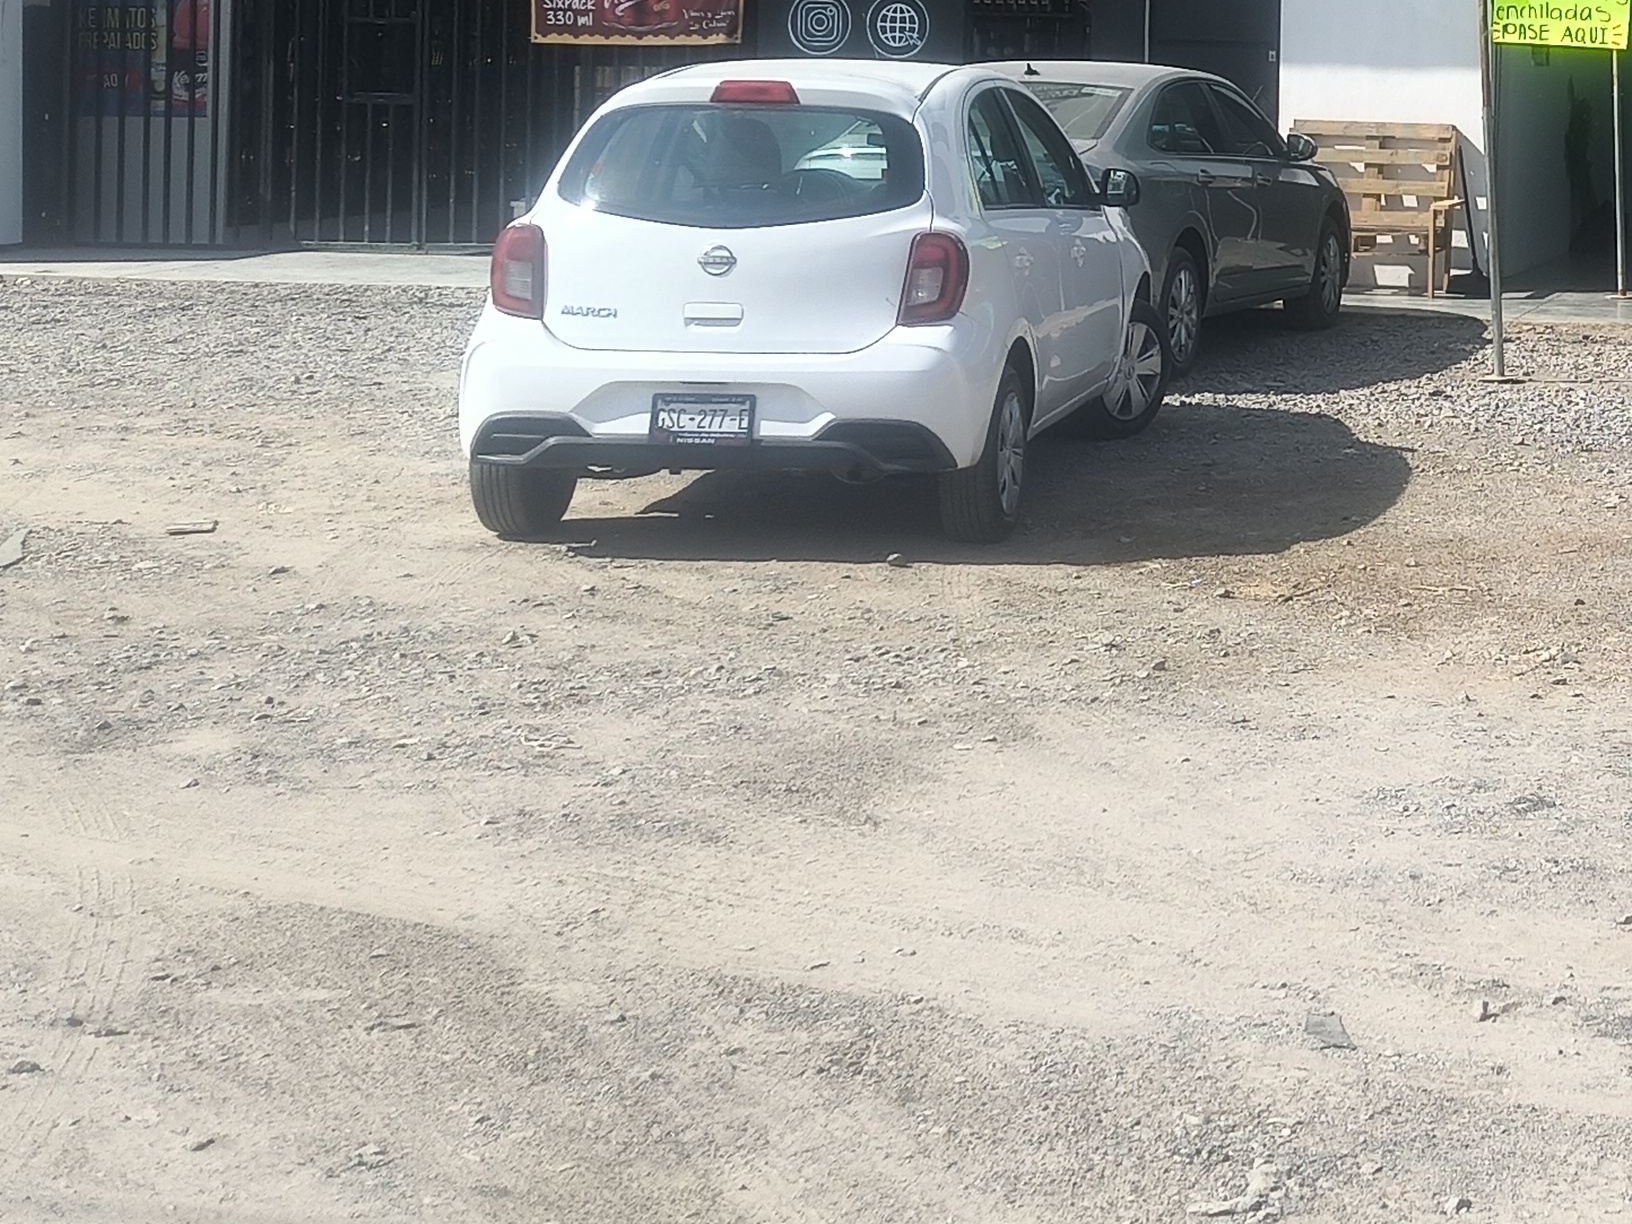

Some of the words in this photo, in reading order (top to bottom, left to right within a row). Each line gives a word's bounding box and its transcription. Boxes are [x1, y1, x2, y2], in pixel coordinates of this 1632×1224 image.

[546, 12, 574, 25] 330
[577, 12, 593, 27] ml
[1496, 2, 1611, 23] enchiladas
[1502, 23, 1550, 41] PASE
[561, 305, 617, 318] MARCH
